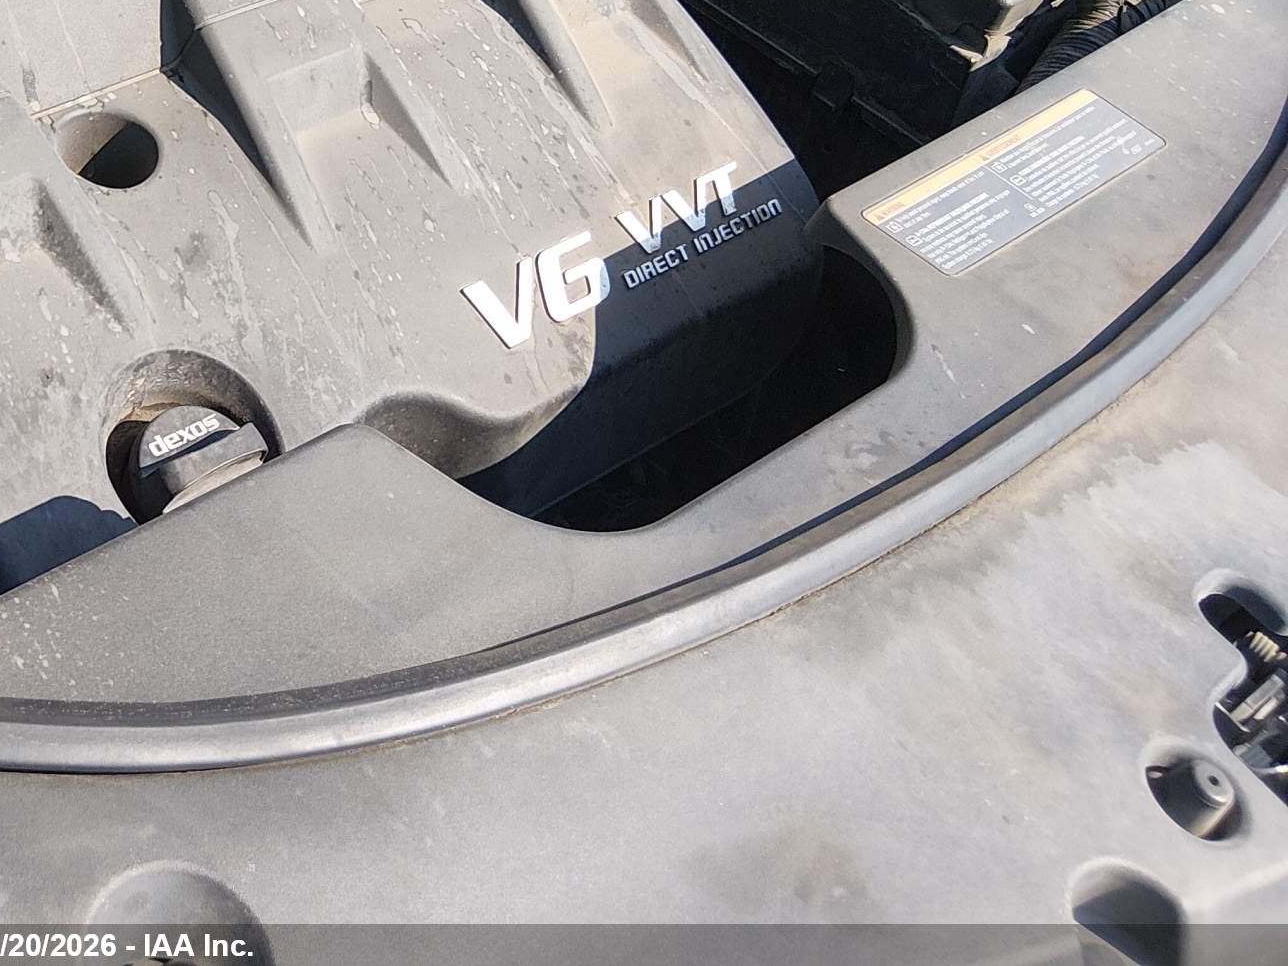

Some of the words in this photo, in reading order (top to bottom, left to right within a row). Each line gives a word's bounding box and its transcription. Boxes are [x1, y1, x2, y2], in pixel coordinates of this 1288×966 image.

[461, 229, 611, 350] V6
[614, 161, 737, 254] VVT
[623, 244, 689, 289] DIRECT
[693, 198, 782, 254] INJECTION
[148, 413, 221, 457] dexos
